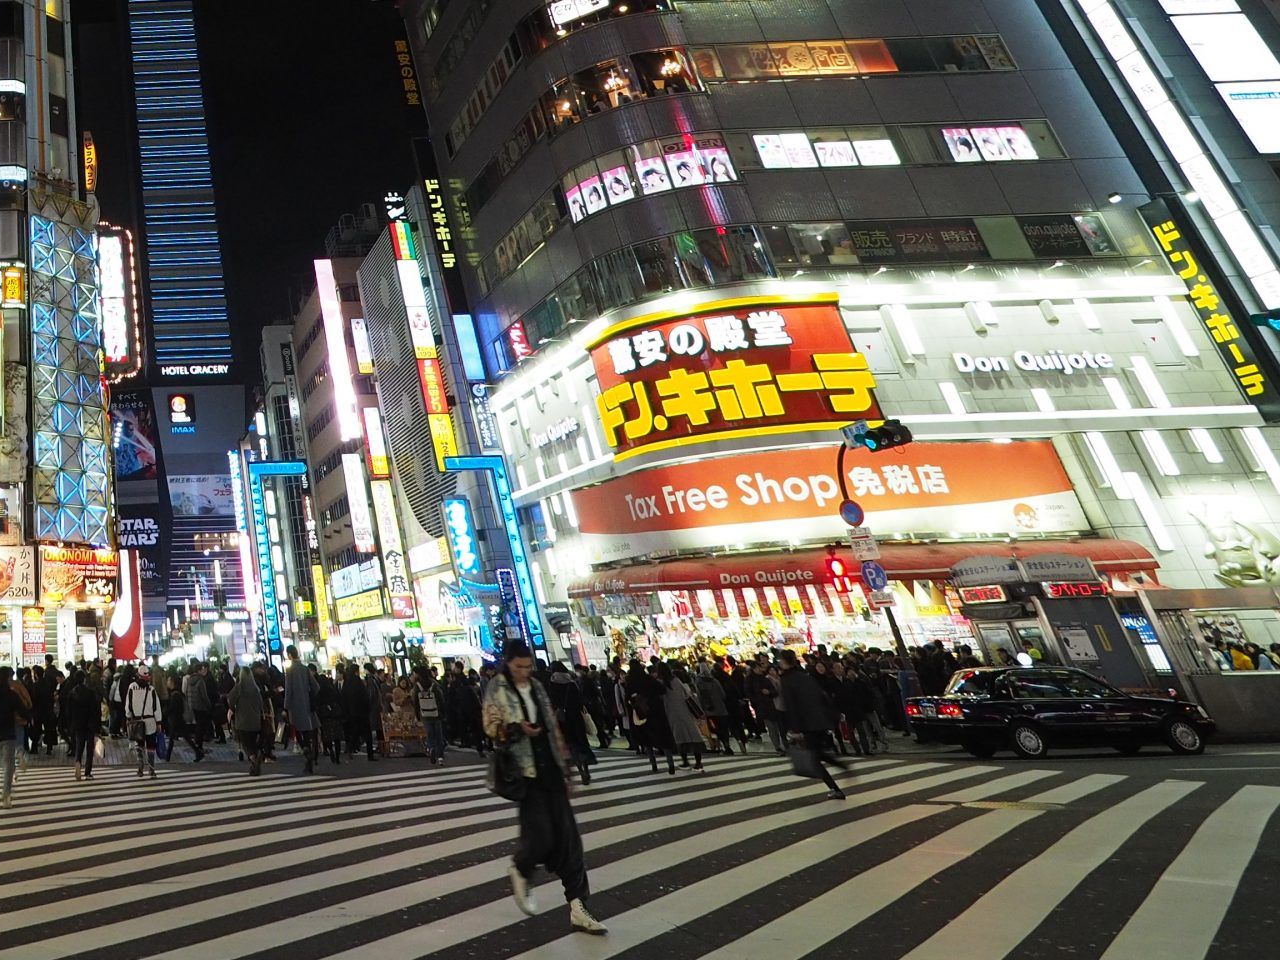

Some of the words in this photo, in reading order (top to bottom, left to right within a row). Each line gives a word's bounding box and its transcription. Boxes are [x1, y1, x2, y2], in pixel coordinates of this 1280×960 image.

[608, 310, 793, 375] 驚安の殿堂
[162, 366, 189, 375] HOTEL
[190, 365, 228, 374] GRACERY
[952, 352, 1009, 373] Don
[1014, 350, 1114, 375] Quijote
[625, 493, 659, 522] Tax
[666, 481, 729, 515] Free
[735, 472, 838, 508] Shop
[847, 463, 950, 497] 免税店
[119, 518, 158, 529] STAR
[252, 489, 269, 570] GODZILLA
[120, 534, 159, 545] WARS
[20, 549, 31, 583] かつ丼
[720, 573, 750, 585] Don
[754, 569, 813, 584] Quijote
